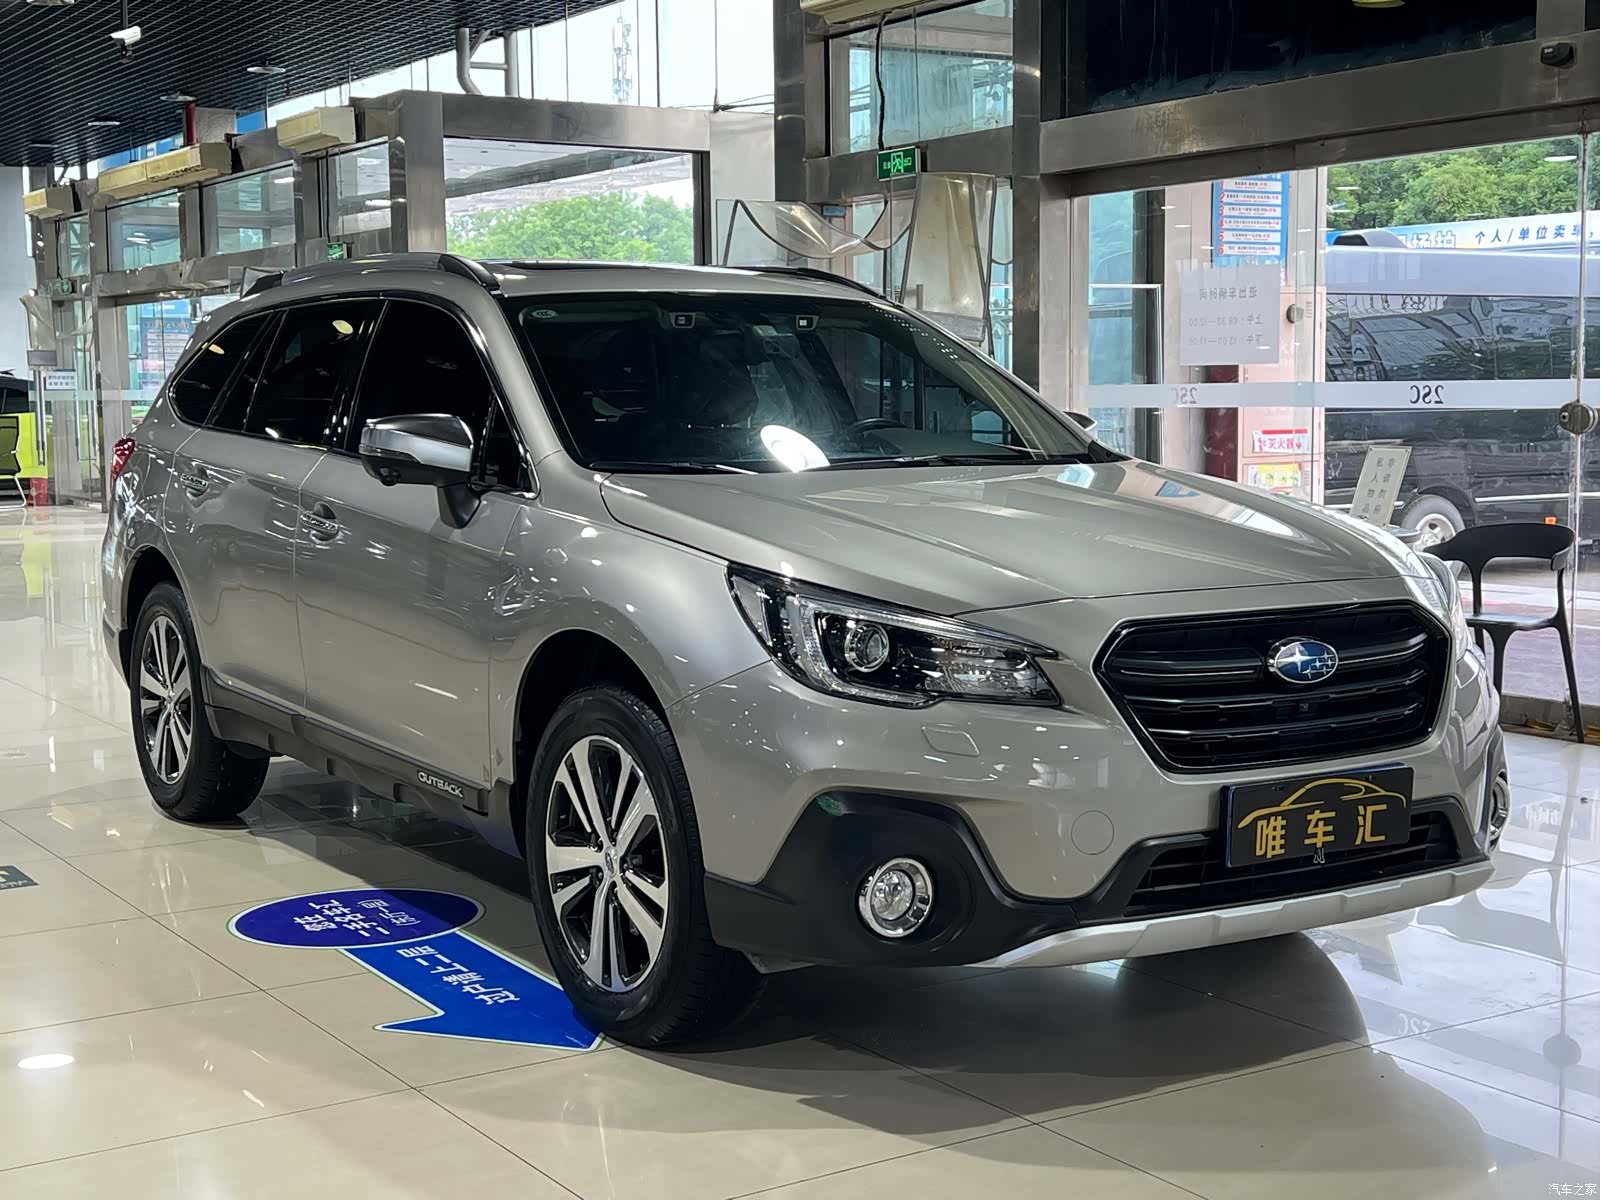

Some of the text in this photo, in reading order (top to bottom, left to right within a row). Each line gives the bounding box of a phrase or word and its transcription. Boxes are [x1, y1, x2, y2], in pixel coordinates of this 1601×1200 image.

[418, 771, 463, 798] OUTBACK
[1255, 804, 1388, 859] 唯车汇
[396, 945, 520, 1005] 过户请上二层
